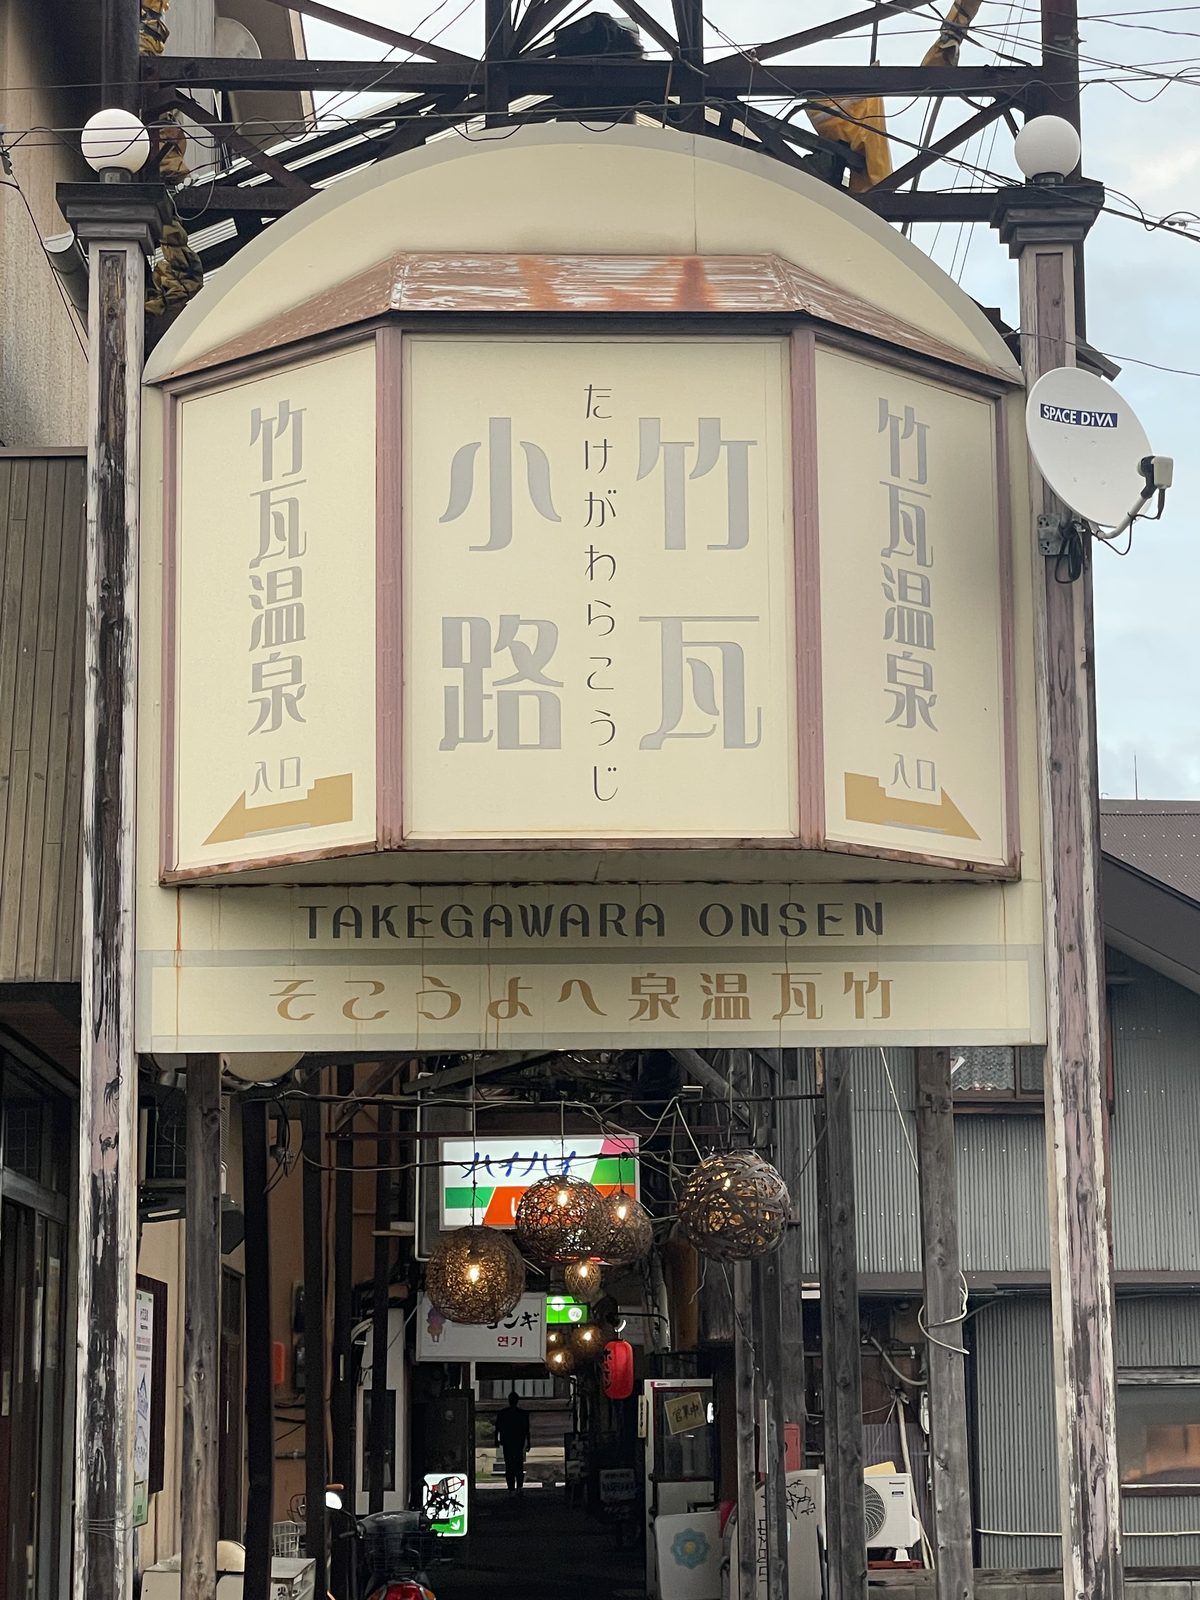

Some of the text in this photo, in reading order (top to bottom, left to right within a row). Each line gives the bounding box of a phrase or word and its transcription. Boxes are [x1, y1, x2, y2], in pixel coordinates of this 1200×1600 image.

[1042, 405, 1077, 424] SPACE
[248, 399, 308, 737] 竹瓦温泉
[877, 397, 938, 733] 竹瓦温泉
[583, 383, 618, 803] たけがわらこうじ
[249, 755, 302, 797] 入口
[889, 752, 937, 793] 入口
[297, 902, 884, 939] TAKEGAWARA ONSEN
[497, 1335, 523, 1348] 연기
